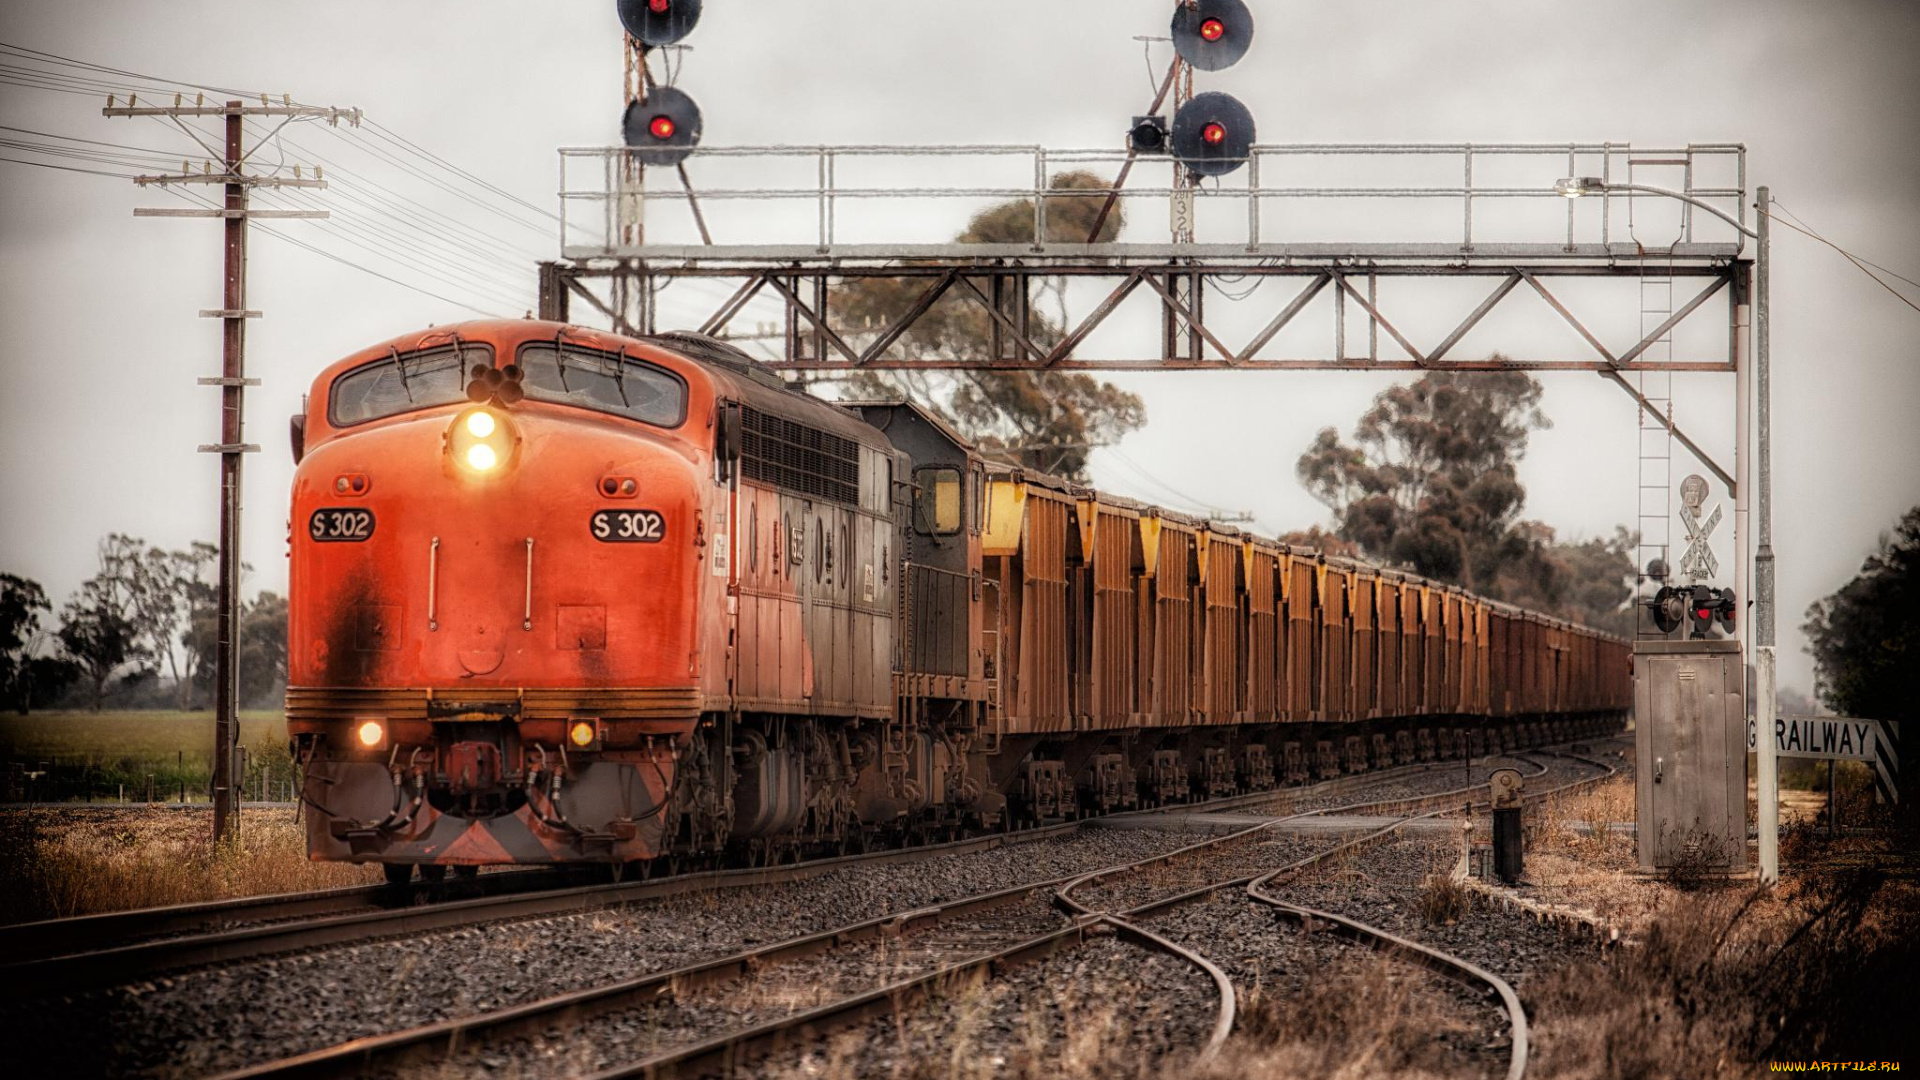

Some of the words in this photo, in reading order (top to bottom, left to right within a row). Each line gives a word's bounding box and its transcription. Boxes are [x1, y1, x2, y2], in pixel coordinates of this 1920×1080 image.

[312, 513, 325, 536] S
[329, 513, 370, 536] 302
[594, 513, 611, 537] S
[617, 513, 661, 537] 302
[1776, 719, 1869, 755] RAILWAY
